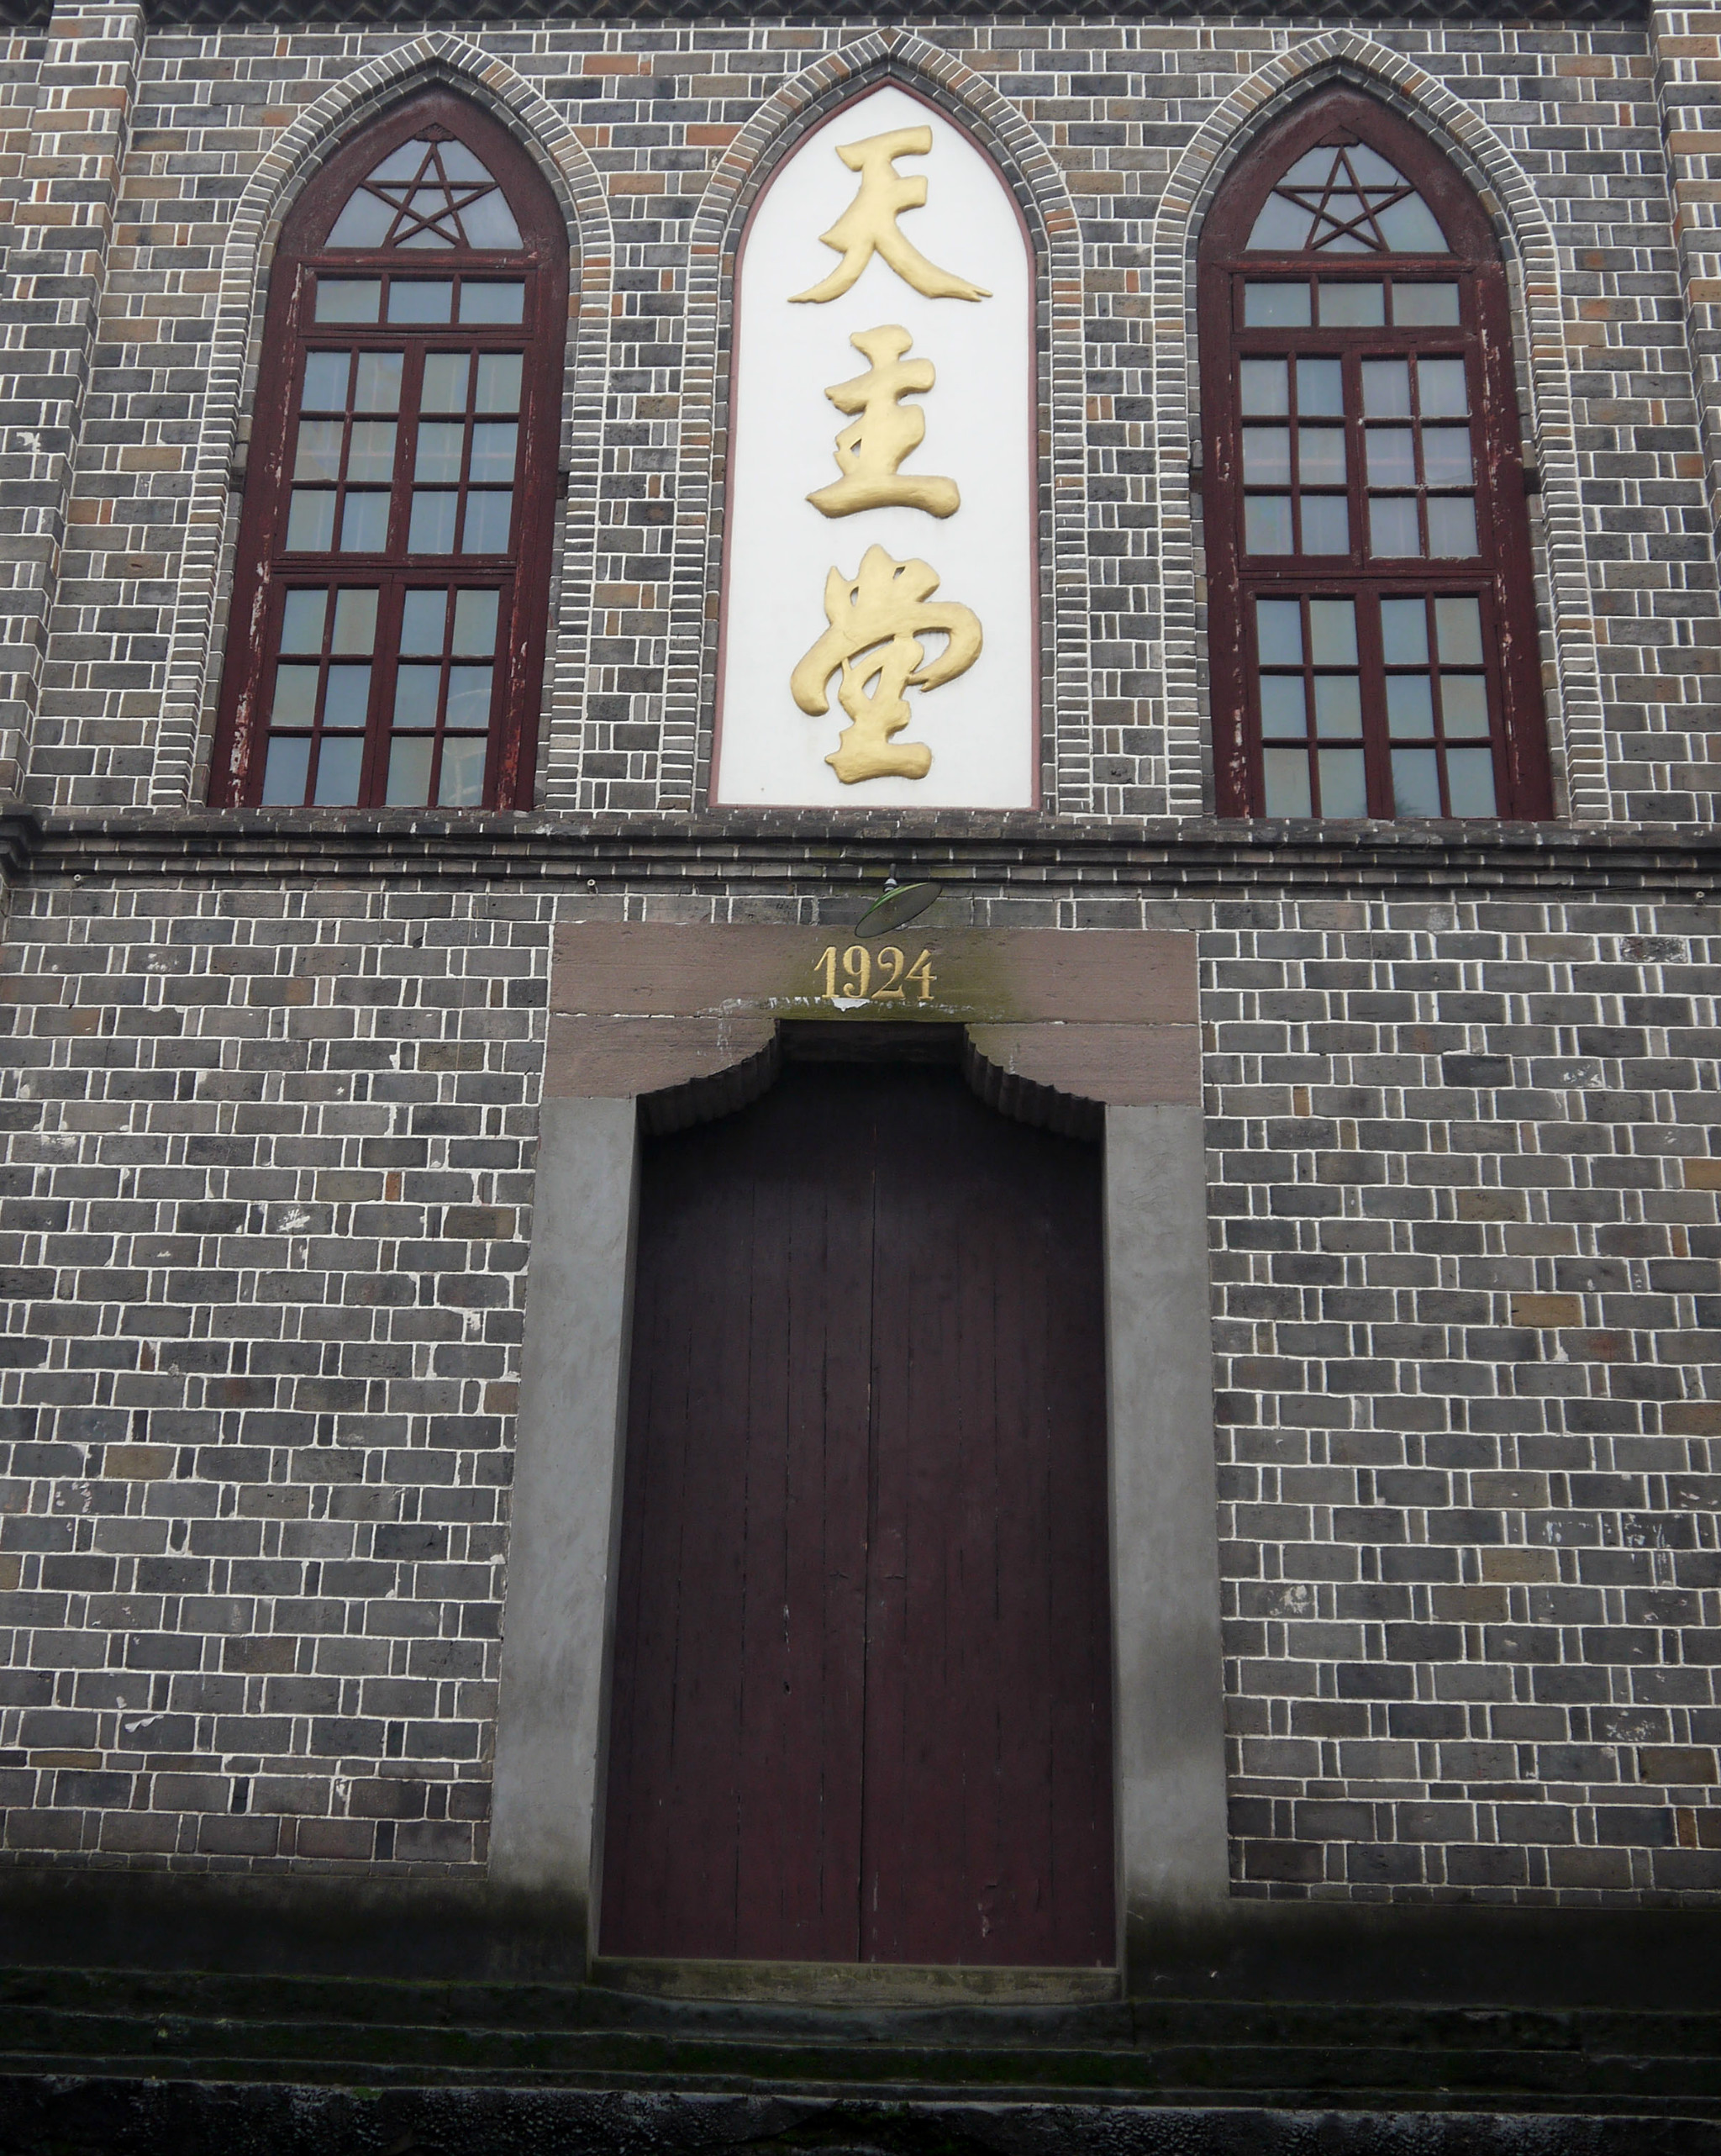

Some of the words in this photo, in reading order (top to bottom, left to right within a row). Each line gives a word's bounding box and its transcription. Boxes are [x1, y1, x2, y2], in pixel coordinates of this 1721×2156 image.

[787, 124, 993, 786] 天主堂
[813, 946, 937, 1000] 1924
